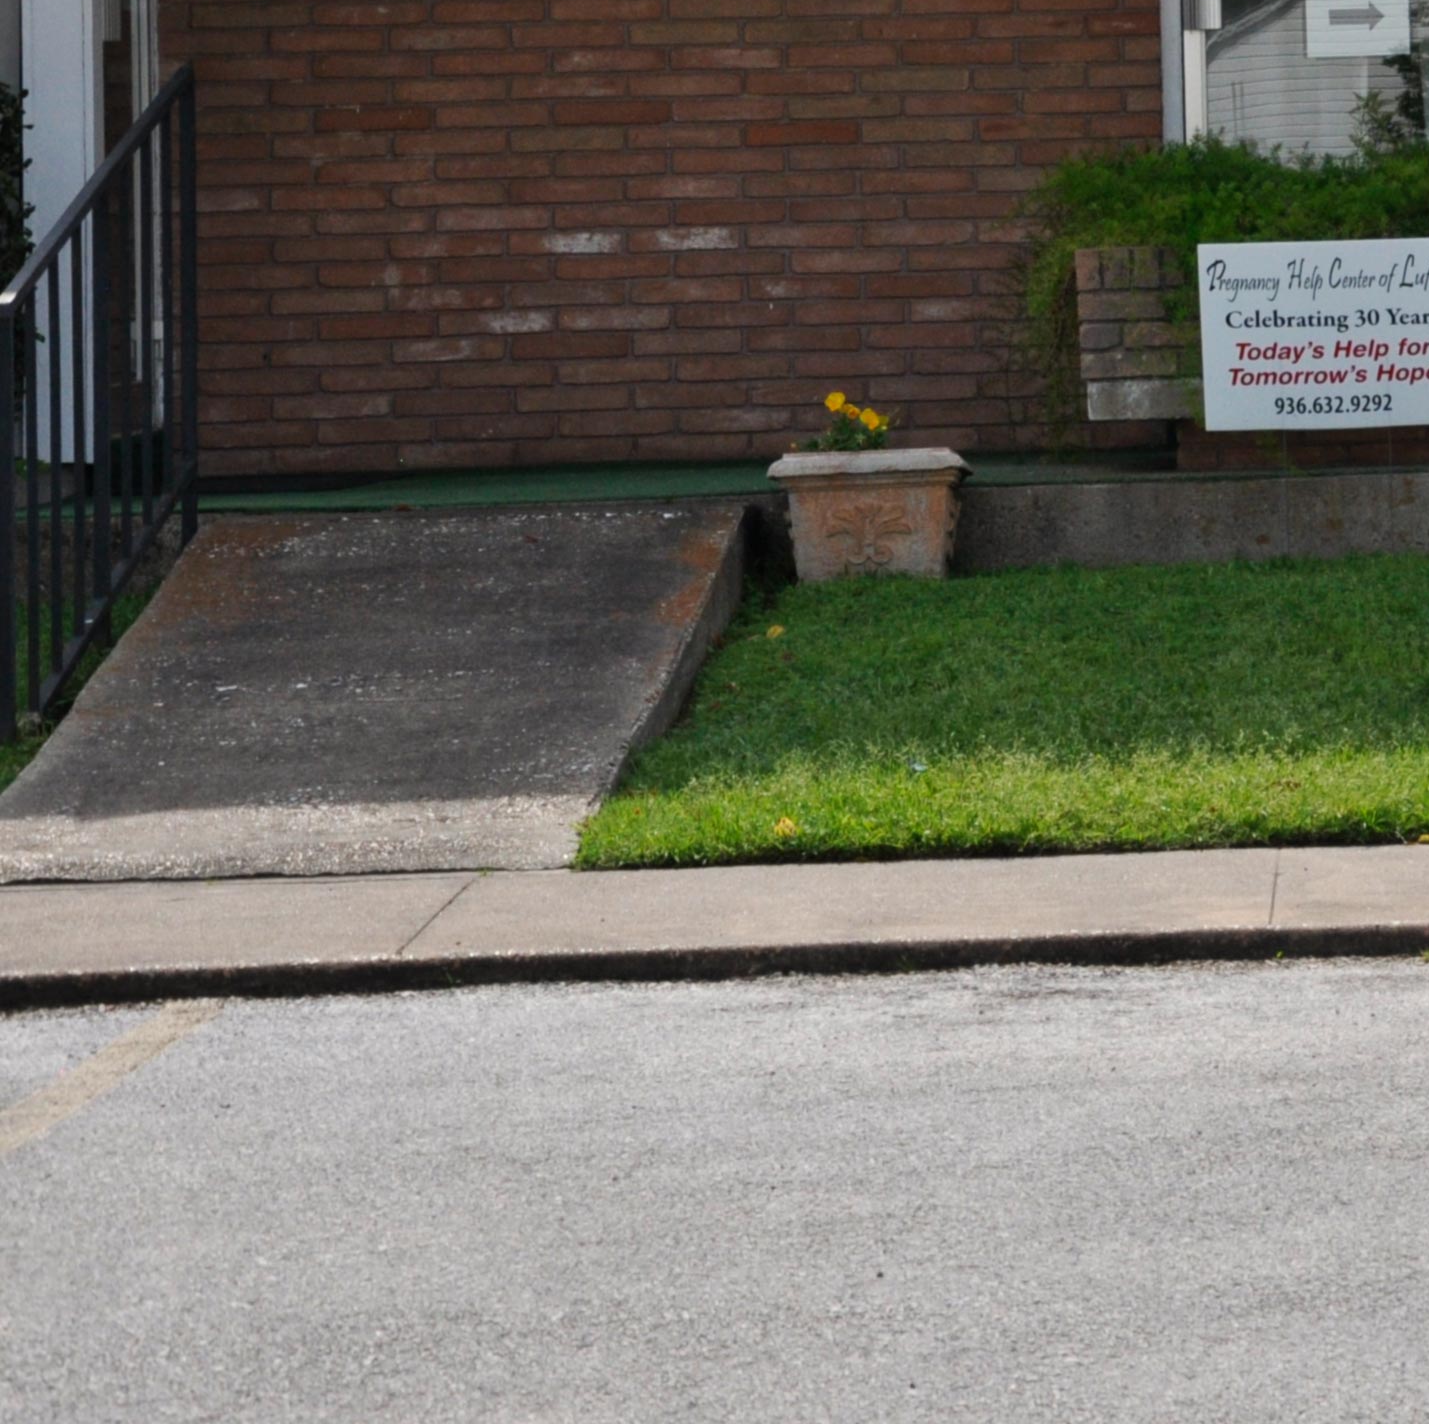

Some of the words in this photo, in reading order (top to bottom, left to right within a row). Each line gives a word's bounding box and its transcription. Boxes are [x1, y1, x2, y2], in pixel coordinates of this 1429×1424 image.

[1206, 259, 1280, 303] Pregnancy
[1287, 257, 1323, 301] Help
[1328, 256, 1376, 290] Center
[1378, 262, 1398, 293] of
[1225, 310, 1349, 333] Celebrating
[1354, 308, 1381, 327] 30
[1235, 340, 1325, 364] Today's
[1333, 339, 1390, 361] Help
[1228, 364, 1368, 387] Tomorrow's
[1274, 393, 1393, 415] 936.632.9292
